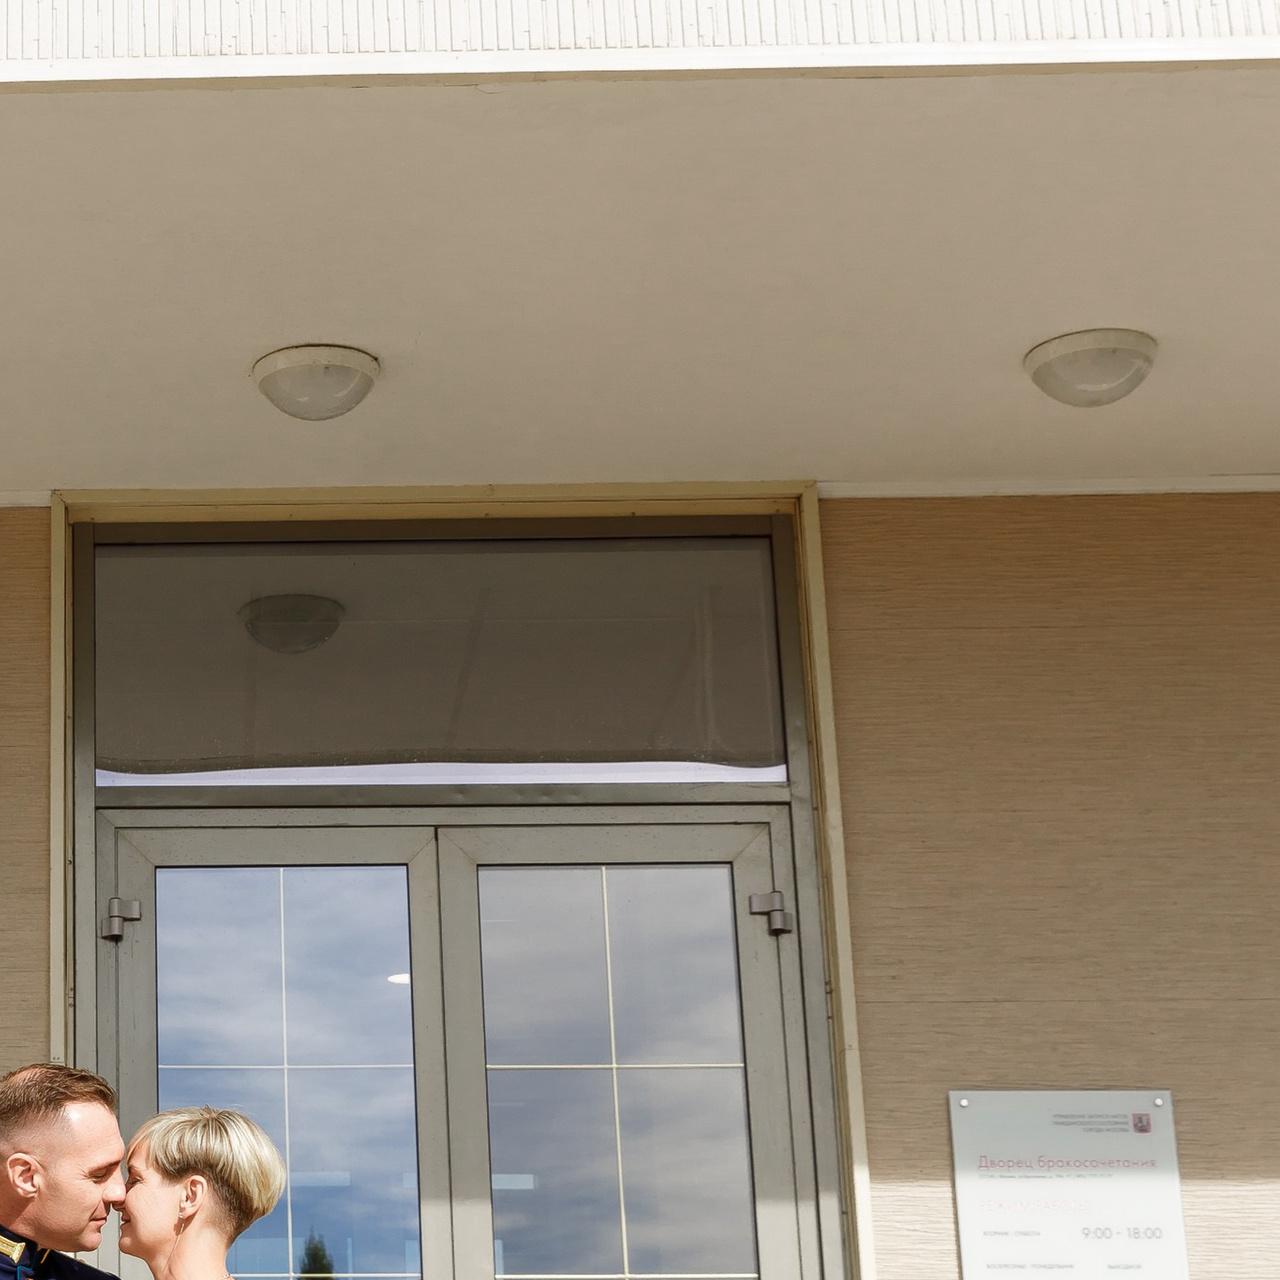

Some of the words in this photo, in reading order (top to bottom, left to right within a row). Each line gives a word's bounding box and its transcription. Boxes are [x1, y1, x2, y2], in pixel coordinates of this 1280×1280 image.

[978, 1155, 1033, 1171] Дворец
[1037, 1155, 1157, 1170] бракосочетания
[1081, 1227, 1113, 1239] 9:00
[1127, 1227, 1163, 1239] 18:00
